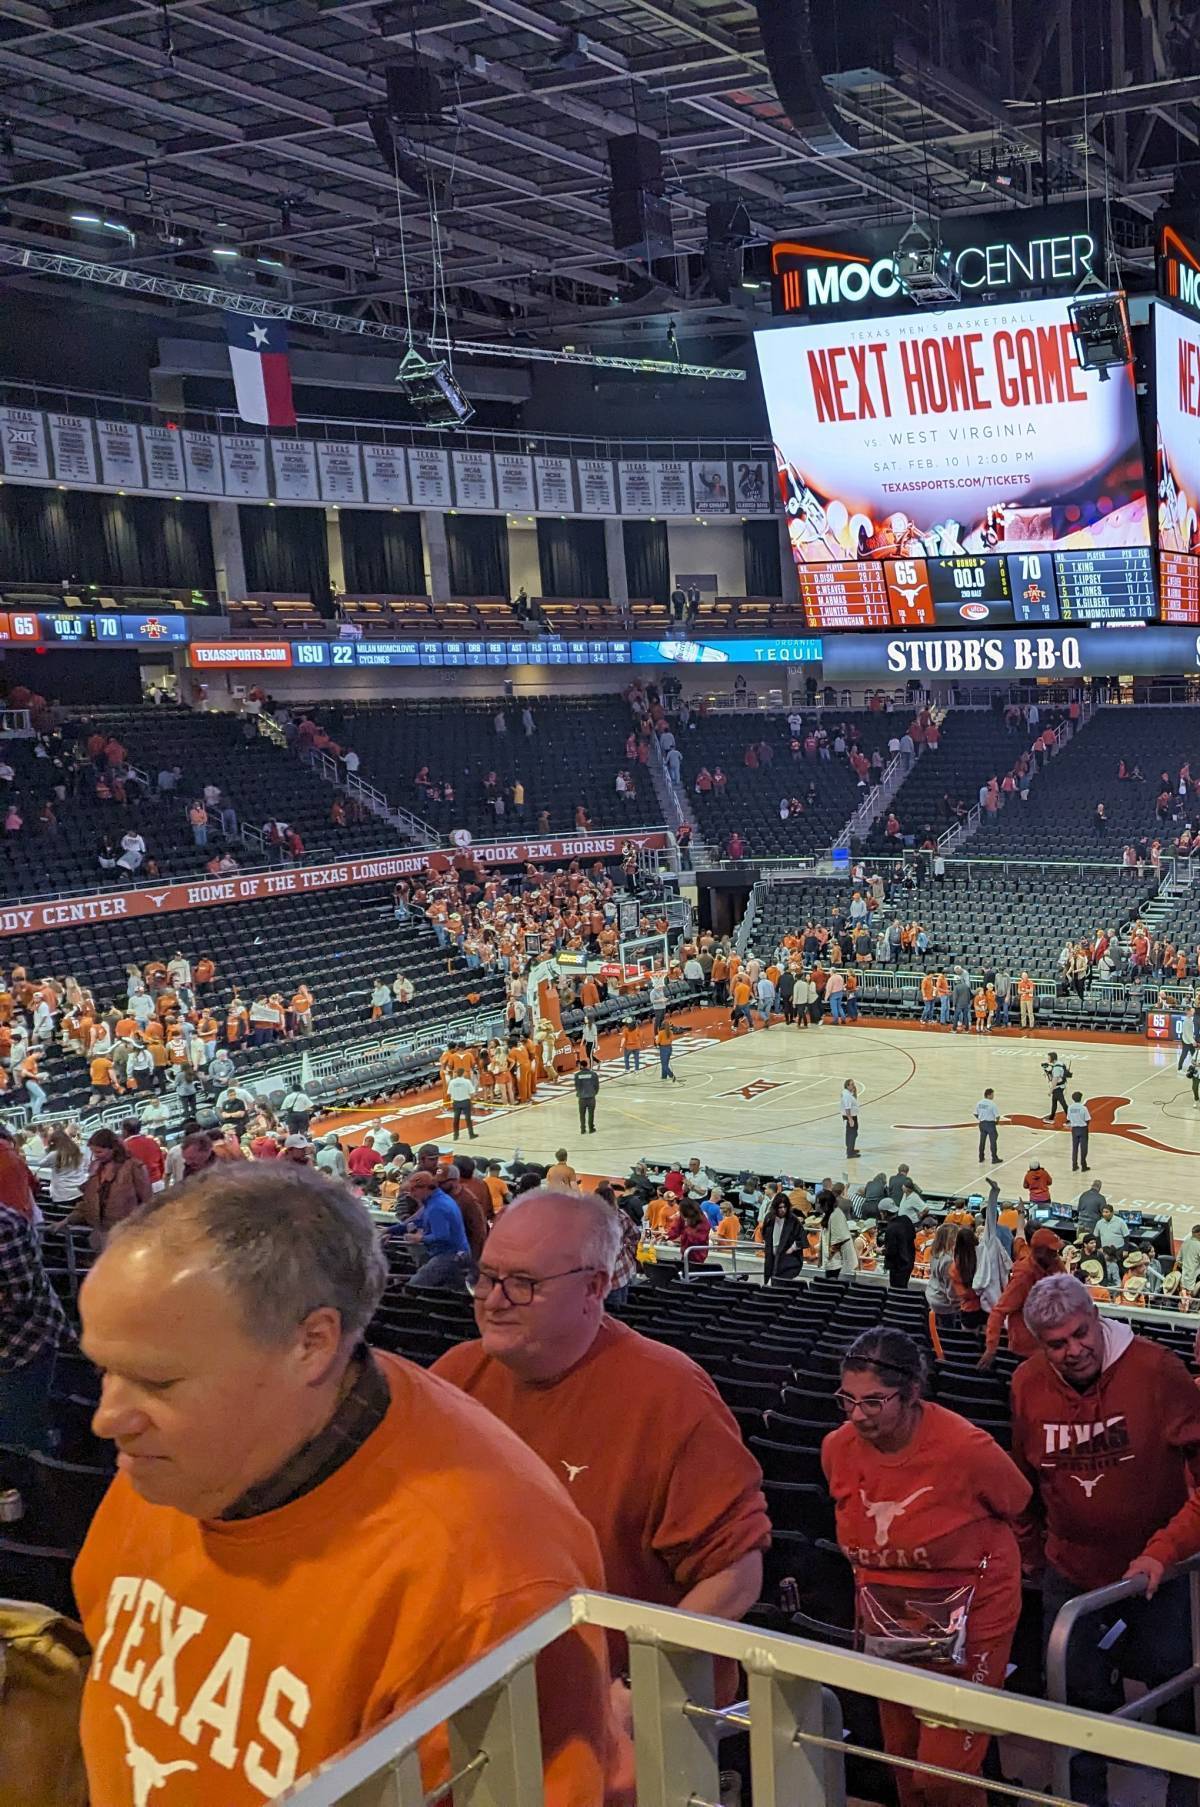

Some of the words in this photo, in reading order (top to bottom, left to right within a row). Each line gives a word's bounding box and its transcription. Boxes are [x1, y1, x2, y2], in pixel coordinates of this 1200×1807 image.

[807, 252, 950, 305] MOO
[955, 234, 1094, 288] CENTER
[850, 329, 890, 340] TEXAS
[899, 323, 938, 335] MEN'S
[947, 314, 1036, 330] BASKETBALL
[806, 342, 893, 423] NEXT
[899, 332, 992, 416] HOME
[992, 322, 1088, 408] GAME
[889, 430, 939, 446] WEST
[949, 422, 1037, 441] VIRGINIA
[281, 442, 305, 451] TEXAS
[326, 445, 350, 453] TEXAS
[371, 447, 396, 456] TEXAS
[416, 450, 440, 459] TEXAS
[460, 454, 483, 462] TEXAS
[502, 457, 525, 465] TEXAS
[542, 459, 563, 467] TEXAS
[584, 462, 606, 470] TEXAS
[873, 461, 902, 472] SAT.
[908, 459, 939, 470] FEB.
[945, 457, 960, 468] 10
[977, 454, 1009, 465] 2:00
[1015, 452, 1035, 462] PM
[626, 463, 647, 471] TEXAS
[661, 463, 682, 471] TEXAS
[881, 473, 1031, 493] TEXASSPORTS.COM/TICKETS
[1019, 555, 1041, 580] 70
[1072, 561, 1094, 572] T.KING
[814, 573, 835, 583] D.DISU
[895, 561, 917, 585] 65
[953, 567, 986, 588] 00.0
[1073, 574, 1101, 585] T.LIPSEY
[815, 584, 846, 595] C.WEAVER
[1074, 585, 1102, 595] C.JONES
[818, 595, 847, 606] M.ABMAS
[1076, 597, 1110, 608] K.GILBERT
[820, 606, 849, 617] T.HUNTER
[1078, 608, 1126, 619] M.MOMCILOVIC
[14, 616, 34, 635] 65
[54, 620, 82, 635] 00.0
[100, 618, 117, 636] 70
[139, 624, 168, 634] STATE
[356, 644, 377, 654] MILAN
[377, 643, 416, 654] MOMCILOVIC
[425, 643, 437, 653] PTS
[511, 643, 522, 653] AST
[195, 648, 286, 662] TEXASSPORTS.COM
[298, 645, 323, 663] ISU
[332, 646, 352, 664] 22
[358, 654, 391, 664] CYCLONES
[754, 648, 823, 661] TEQUIL
[887, 638, 1004, 672] STUBB'S
[1014, 636, 1081, 670] B-B-Q
[787, 666, 803, 675] 104
[473, 845, 519, 863] HOOK
[522, 843, 558, 859] 'EM.
[561, 838, 616, 855] HORNS
[188, 885, 236, 904] HOME
[240, 881, 260, 896] OF
[264, 875, 297, 894] THE
[300, 869, 349, 888] TEXAS
[352, 856, 430, 881] LONGHORNS
[42, 898, 127, 925] CENTER
[1153, 1014, 1165, 1028] 65
[1043, 1415, 1130, 1456] TEXAS
[93, 1576, 311, 1800] TEXAS
